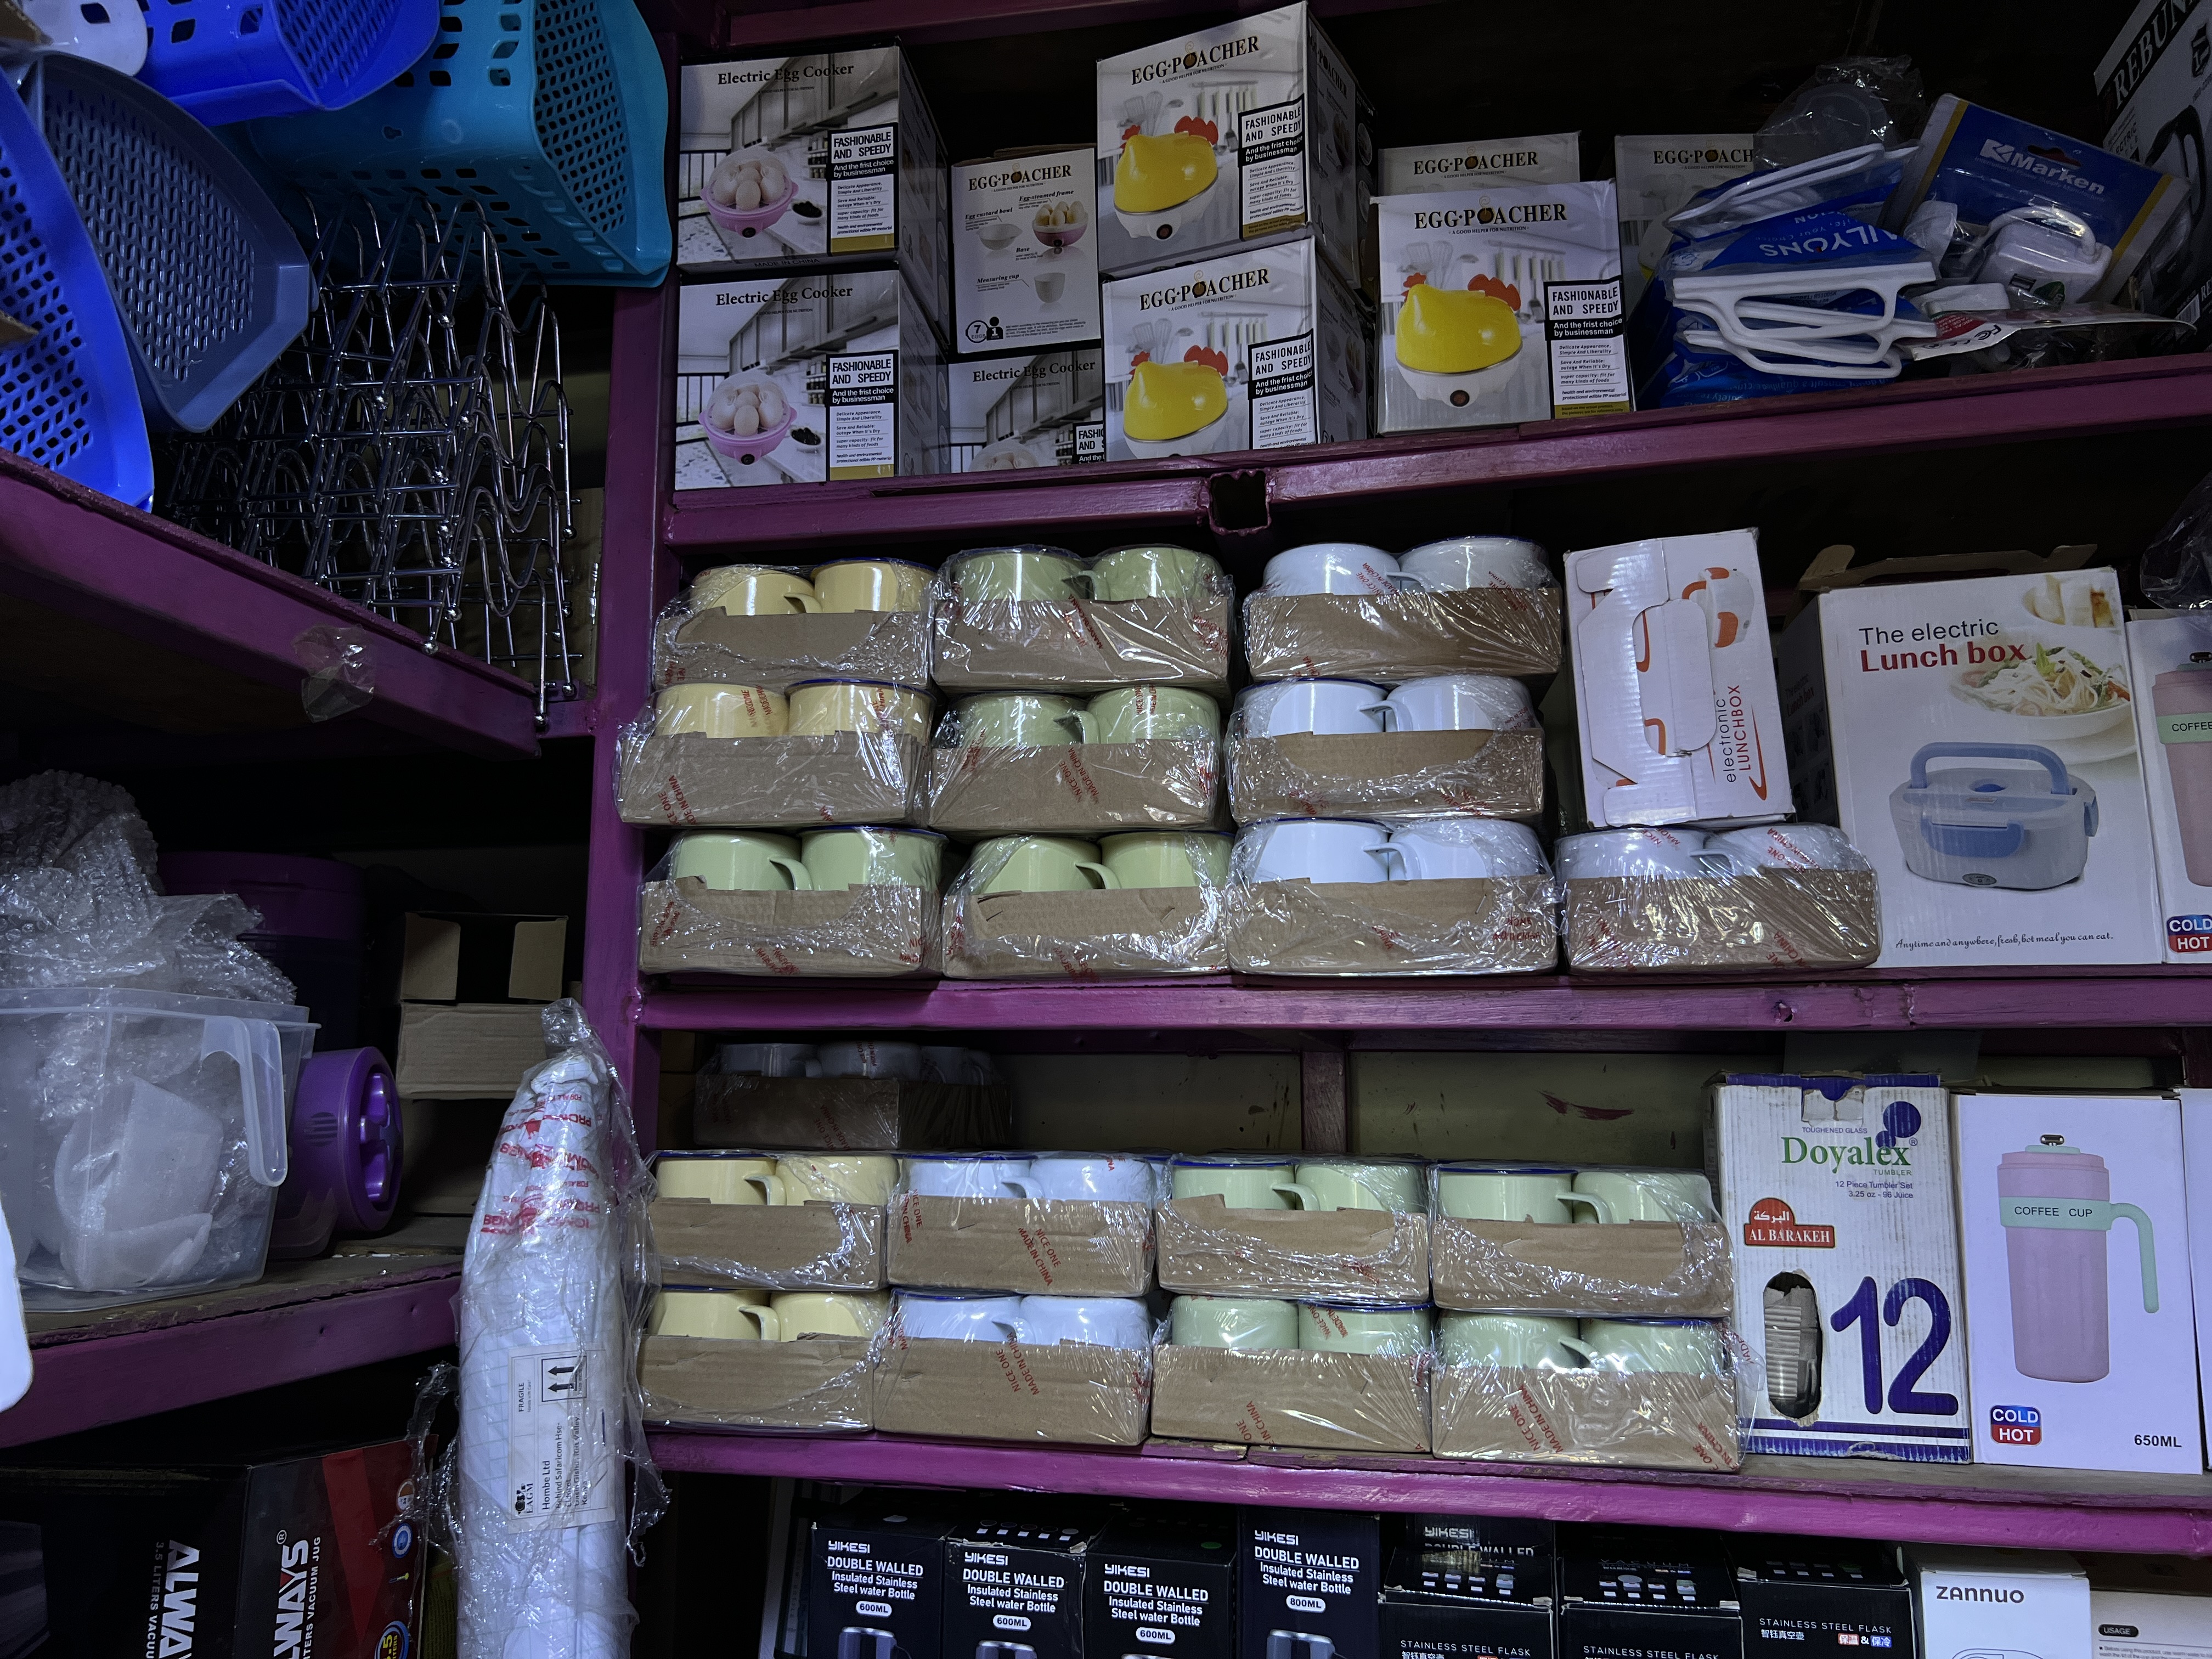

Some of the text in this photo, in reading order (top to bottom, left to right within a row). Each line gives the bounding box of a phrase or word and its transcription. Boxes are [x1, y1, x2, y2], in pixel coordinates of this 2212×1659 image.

[718, 64, 854, 84] Electric Egg Cooker
[834, 132, 891, 148] FASHIONABLE
[834, 144, 891, 159] AND SPEEDY
[2011, 153, 2105, 195] Marken
[1019, 189, 1074, 203] Egg-steamed frame
[978, 210, 998, 218] custard
[977, 274, 1007, 285] Measuring
[716, 286, 853, 306] Electric Egg Cooker
[1553, 286, 1618, 302] FASHIONABLE
[1553, 301, 1618, 315] AND SPEEDY
[973, 325, 981, 333] 7
[1582, 320, 1597, 328] frist
[1599, 318, 1622, 327] choice
[1564, 328, 1613, 336] businessman
[832, 359, 891, 373] FASHIONABLE
[973, 360, 1096, 383] Electric Egg Cooker
[832, 371, 891, 384] AND SPEEDY
[842, 394, 885, 403] businessman
[872, 387, 894, 395] choice
[1859, 619, 1999, 645] The electric
[1860, 641, 2027, 672] Lunch box
[1728, 685, 1751, 771] LUNCHBOX
[2172, 721, 2212, 731] COFFEE
[1716, 698, 1736, 782] electronic
[2169, 918, 2212, 933] COLD
[1895, 939, 1934, 951] Anytime
[1935, 938, 1951, 946] and
[2036, 932, 2060, 943] meal
[2061, 935, 2075, 944] you
[2177, 936, 2210, 950] HOT
[1781, 1137, 1911, 1173] Doyalex
[2015, 1206, 2092, 1217] COFFEE CUP
[1749, 1229, 1830, 1243] AL BARAKEH
[1036, 1228, 1061, 1267] NICE ONE
[1018, 1228, 1053, 1286] MADE IN CHINA
[1831, 1276, 1959, 1415] 12
[996, 1348, 1021, 1392] NICE ONE
[1017, 1359, 1026, 1369] IN
[1022, 1368, 1040, 1395] MADE
[1993, 1408, 2039, 1423] COLD
[1999, 1427, 2034, 1442] HOT
[2134, 1434, 2182, 1447] 650ML
[542, 1477, 550, 1510] Hombe
[1255, 1545, 1359, 1570] DOUBLE WALLED
[827, 1556, 923, 1576] DOUBLE WALLED
[1260, 1561, 1353, 1584] Insulated Stainless
[307, 1536, 320, 1620] VACUUM JUG
[963, 1568, 1064, 1588] DOUBLE WALLED
[1263, 1575, 1351, 1595] Steel water Bottle
[150, 1565, 165, 1611] LITERS
[967, 1584, 1058, 1601] Insulated Stainless
[159, 1539, 200, 1659] ALWA
[969, 1596, 1056, 1612] Steel water Bottle
[1290, 1598, 1322, 1609] 800ML
[860, 1604, 888, 1613] 600ML
[997, 1617, 1027, 1627] 600ML
[1759, 1618, 1892, 1634] STAINLESS STEEL FLASK
[1401, 1640, 1531, 1656] STAINLESS STEEL FLASK
